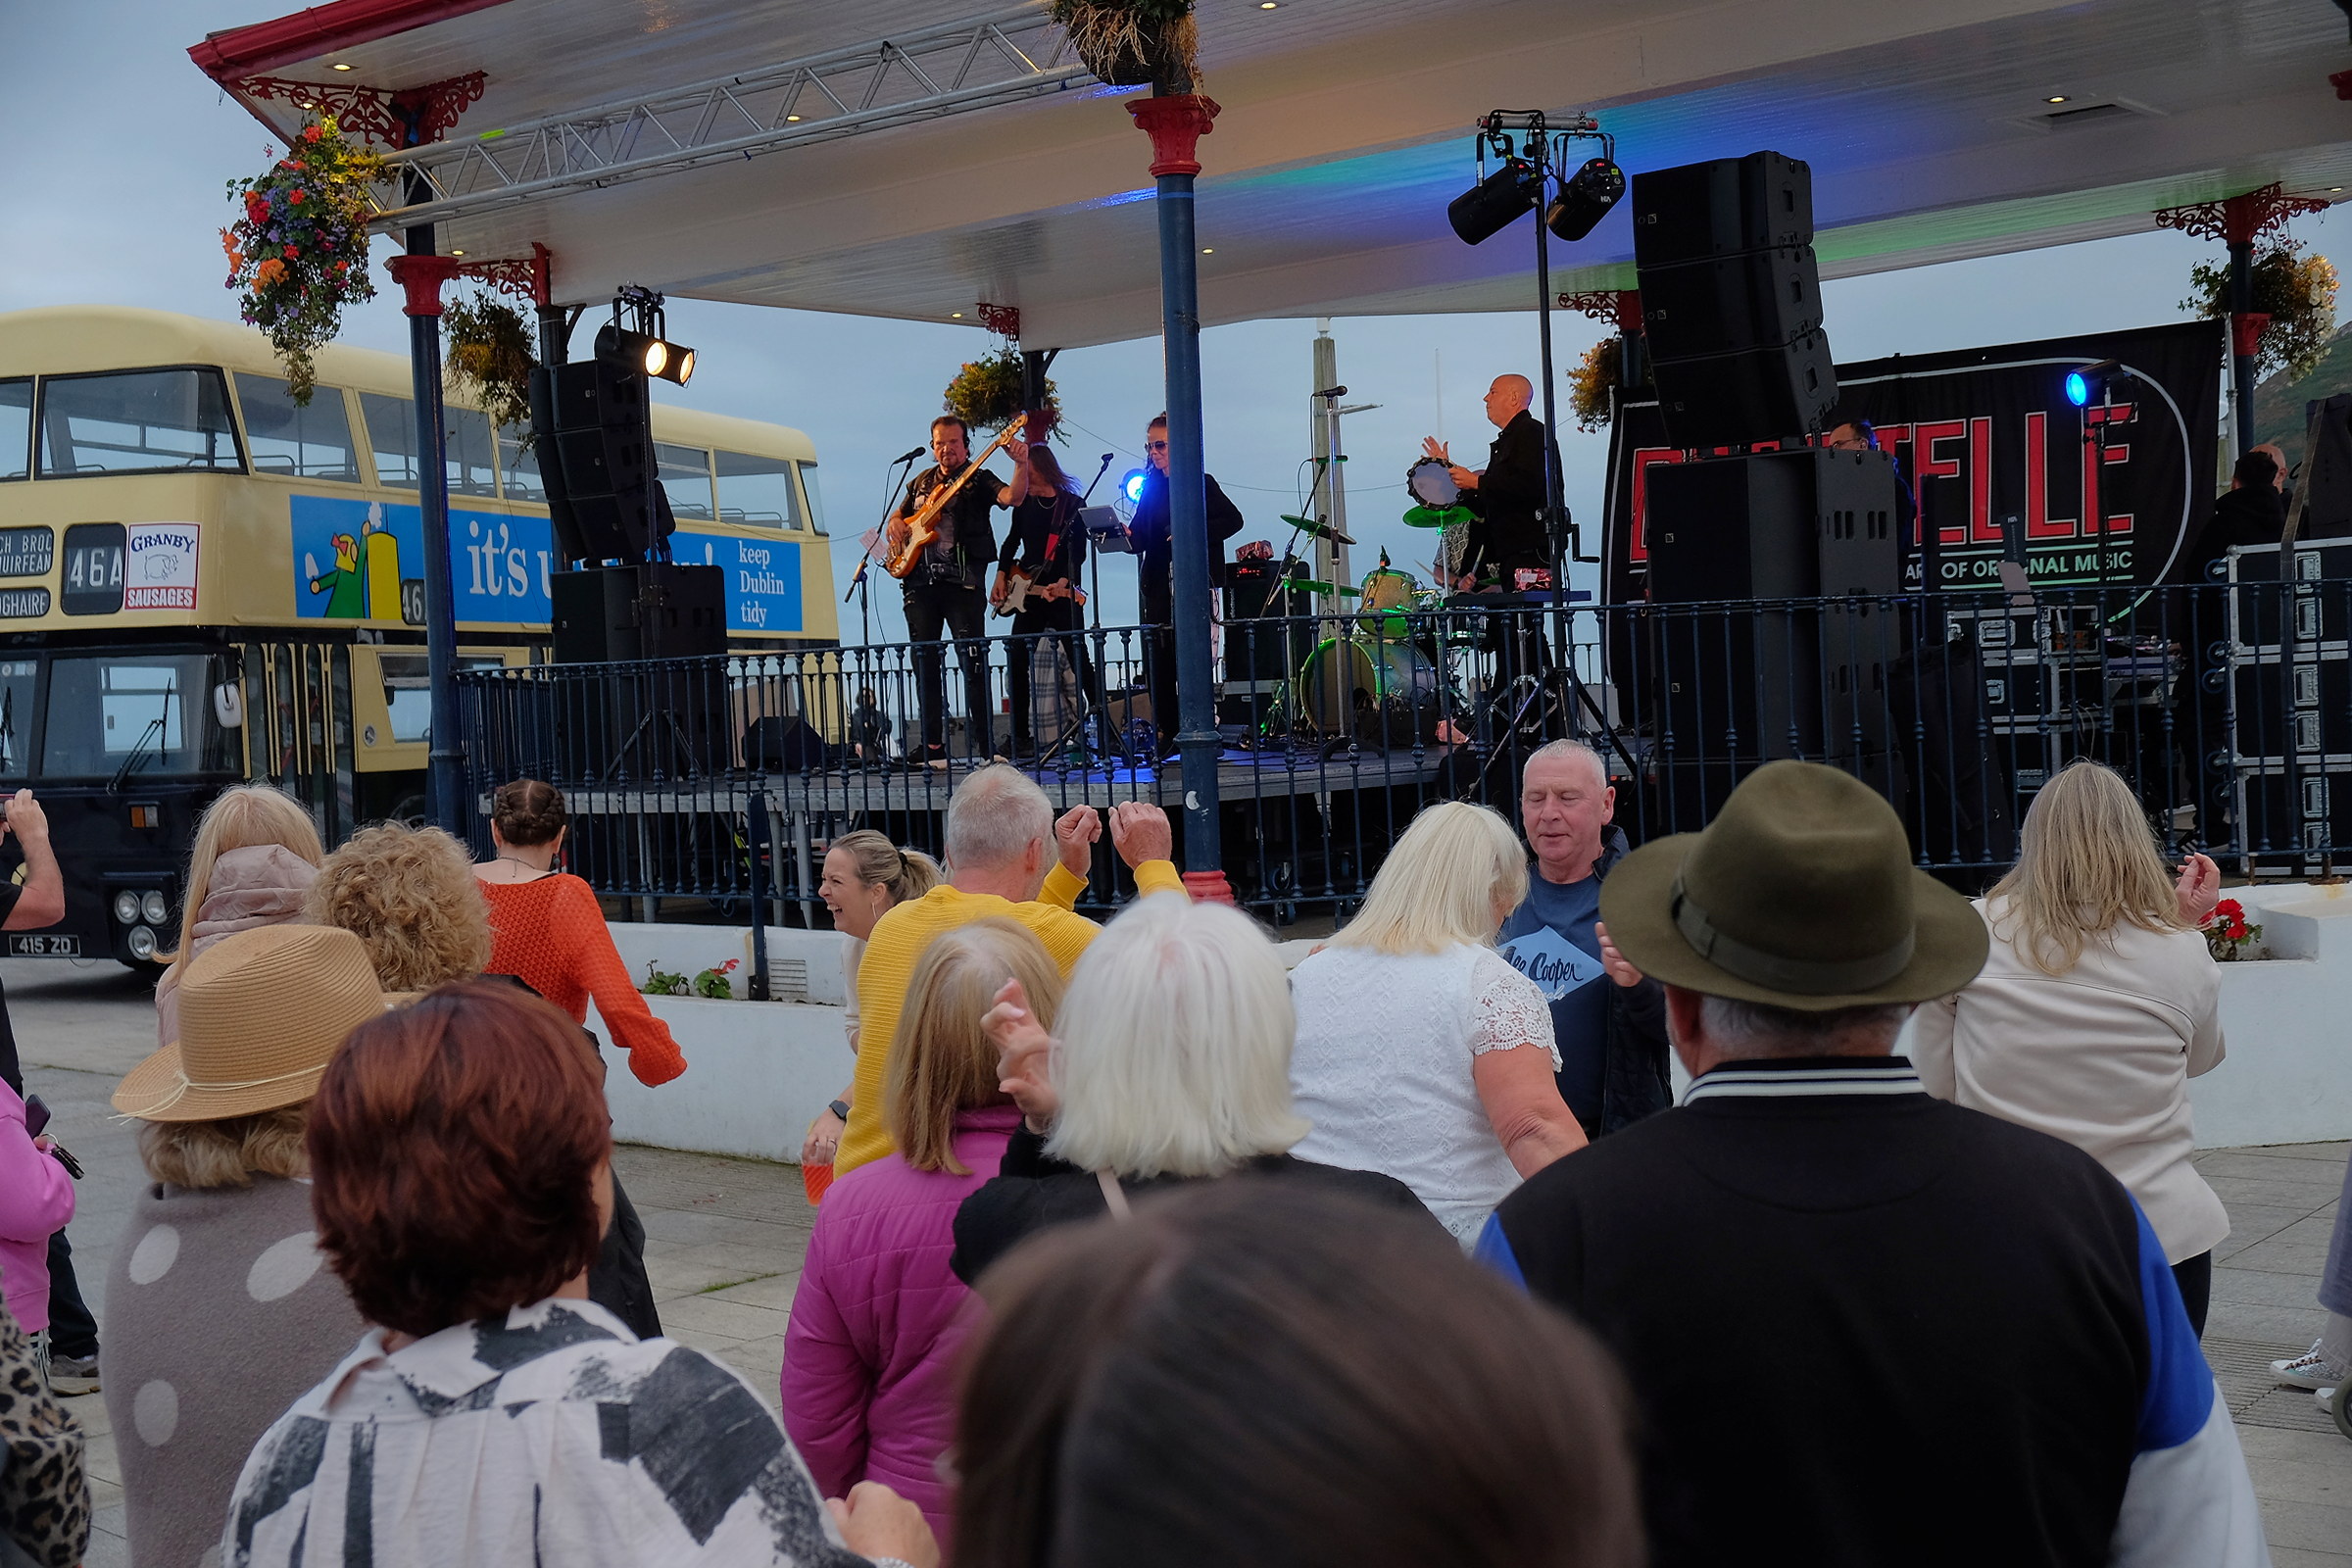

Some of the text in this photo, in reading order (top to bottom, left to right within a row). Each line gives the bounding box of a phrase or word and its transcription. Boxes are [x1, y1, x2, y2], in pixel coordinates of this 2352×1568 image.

[130, 532, 196, 554] GRANBY
[738, 540, 770, 569] keep
[0, 553, 52, 573] UIRFEAN
[70, 547, 122, 588] 46A
[466, 520, 528, 598] it's
[1940, 561, 1968, 579] OF
[1973, 556, 2070, 577] ORNAL
[739, 570, 785, 595] Dublin
[0, 592, 47, 616] GHAIRE
[127, 588, 194, 609] SAUSAGES
[740, 601, 767, 628] tidy
[19, 937, 45, 954] 415
[1529, 952, 1584, 990] Cooper
